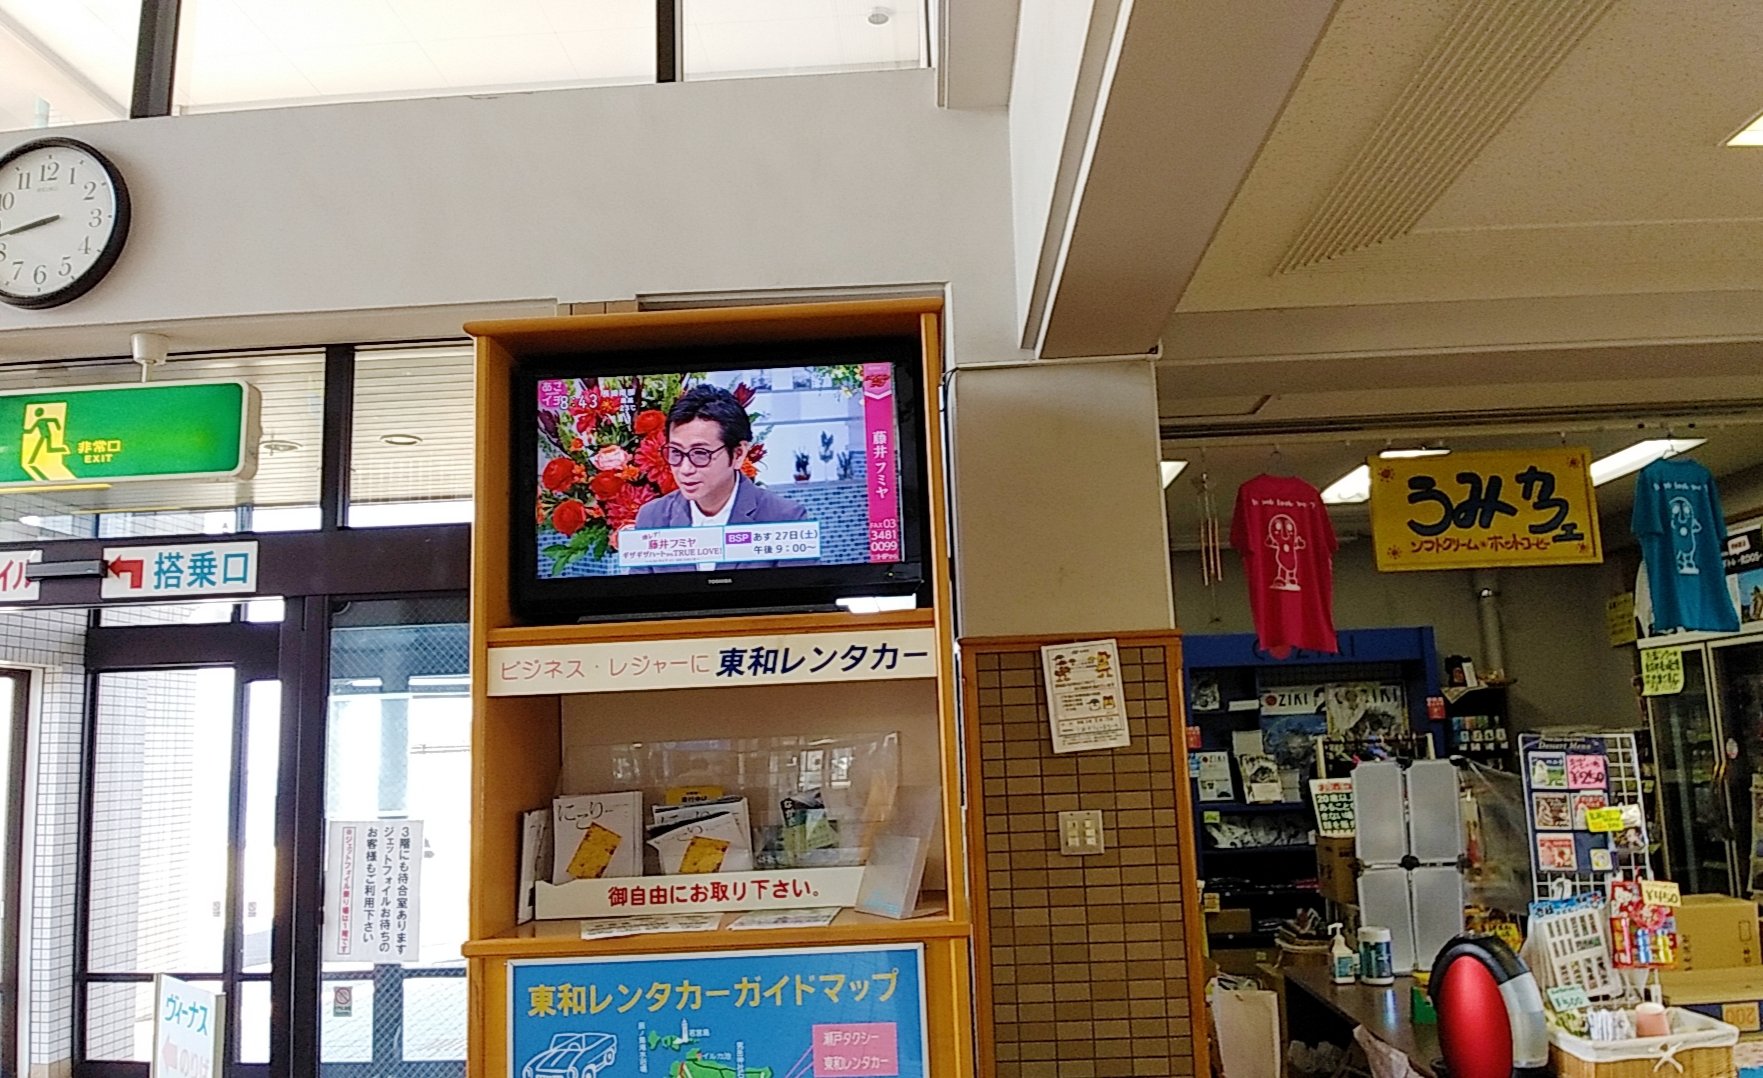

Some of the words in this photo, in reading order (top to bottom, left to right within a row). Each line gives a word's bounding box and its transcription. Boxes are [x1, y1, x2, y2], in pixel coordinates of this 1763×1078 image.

[17, 172, 32, 190] 11
[40, 161, 59, 182] 12
[69, 167, 77, 185] 1
[83, 181, 97, 200] 2
[88, 208, 102, 228] 3
[78, 236, 91, 255] 4
[12, 261, 24, 280] 7
[33, 264, 47, 284] 6
[58, 256, 72, 276] 5
[560, 393, 598, 409] 8:43
[77, 440, 122, 454] 非常口
[84, 454, 113, 463] EXIT
[872, 430, 889, 499] 藤井フミヤ
[883, 518, 897, 528] 03
[728, 533, 750, 543] BSP
[871, 529, 897, 541] 3481
[870, 541, 898, 552] 0099
[153, 550, 250, 590] 搭乗口
[715, 642, 929, 677] 東和レンタカー
[1570, 769, 1605, 785] ¥250
[379, 826, 394, 953] ジェットフォイルお待ちの
[608, 879, 820, 908] 御自由にお取り下さい。
[527, 967, 900, 1018] 東和レンタカーガイドマップ
[164, 994, 208, 1036] ヴィーナス
[823, 1030, 880, 1046] 瀬戸タクシー
[823, 1056, 889, 1071] 東和レンタカー
